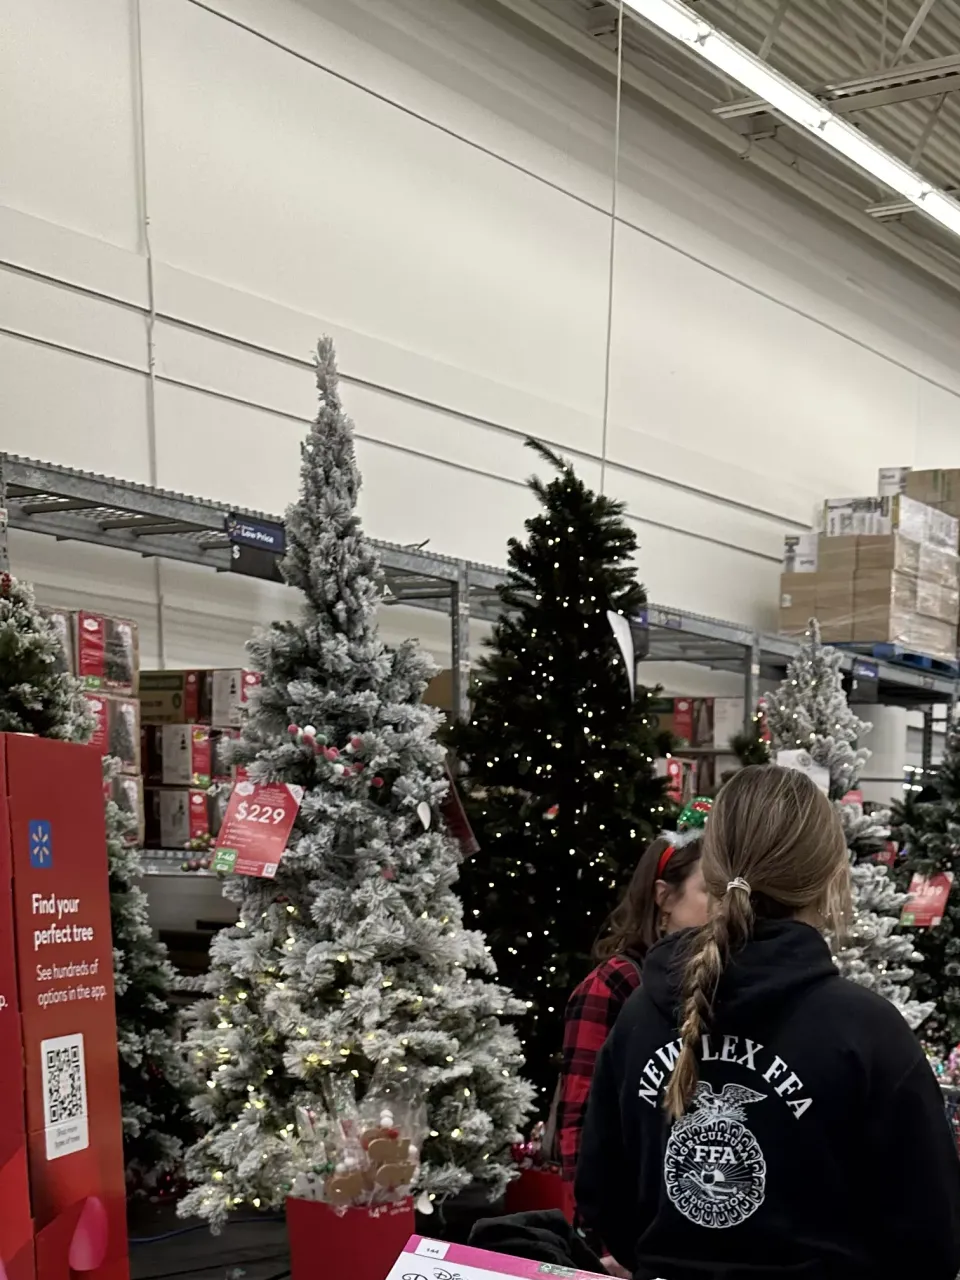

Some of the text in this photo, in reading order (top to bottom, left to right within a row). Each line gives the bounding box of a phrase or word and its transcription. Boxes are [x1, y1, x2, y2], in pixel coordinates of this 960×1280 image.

[234, 800, 286, 825] $229
[31, 893, 80, 920] Find your
[33, 922, 94, 952] perfect tree
[36, 958, 99, 981] See hundreds of
[37, 987, 67, 1010] options
[67, 985, 76, 1002] in
[76, 983, 91, 999] the
[701, 1034, 765, 1071] LEX
[762, 1054, 814, 1121] FFA
[676, 1131, 752, 1168] AGRICULTURAL
[693, 1145, 739, 1165] FFA
[683, 1189, 746, 1213] EDUCATION
